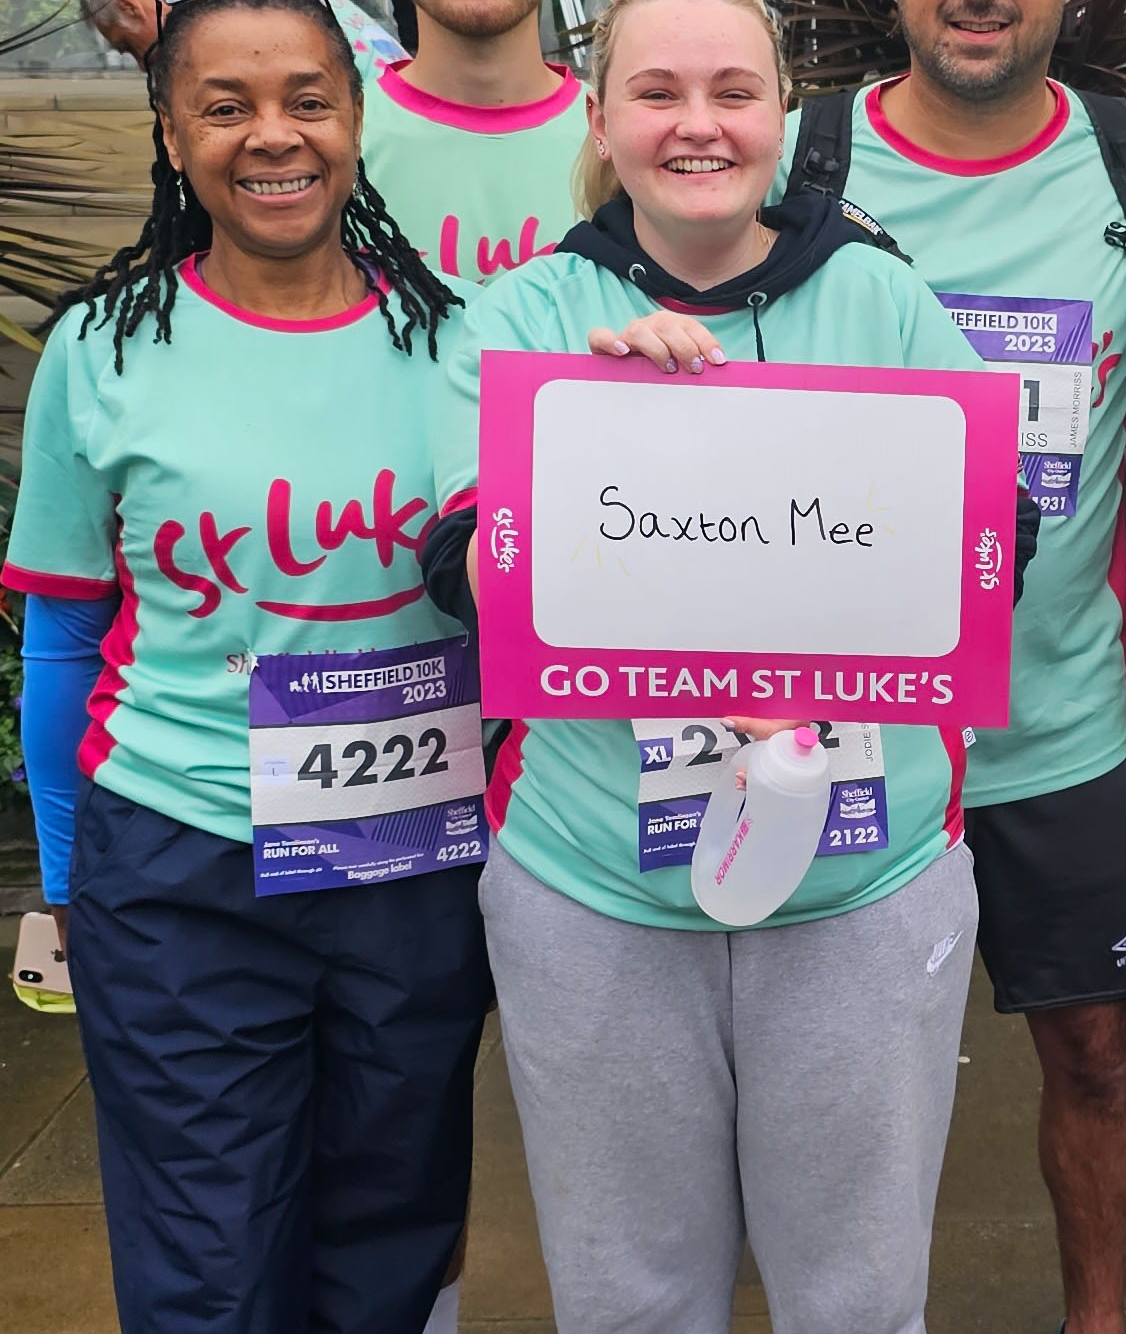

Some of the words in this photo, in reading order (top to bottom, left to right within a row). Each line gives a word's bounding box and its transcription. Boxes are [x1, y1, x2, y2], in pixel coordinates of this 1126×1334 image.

[951, 310, 1019, 330] EFFIELD
[1022, 315, 1055, 331] 10K
[1004, 334, 1056, 353] 2023
[1071, 371, 1082, 416] MORRISS
[1069, 416, 1079, 447] JAMES
[266, 468, 440, 577] Luk
[599, 485, 770, 545] Saxton
[790, 497, 874, 547] Mee
[497, 529, 520, 573] Luke's
[974, 527, 997, 570] Luke's
[325, 666, 413, 691] SHEFFIELD
[415, 661, 445, 678] 10K
[540, 664, 610, 697] GO
[618, 666, 739, 698] TEAM
[751, 669, 801, 700] ST
[814, 670, 954, 705] LUKE'S
[402, 680, 447, 705] 2023
[297, 727, 449, 789] 4222
[643, 744, 673, 765] XL
[681, 721, 840, 767] 22
[863, 732, 874, 762] JODIE
[647, 821, 673, 836] RUN
[674, 818, 697, 831] FOR
[829, 825, 880, 847] 2122
[263, 847, 290, 860] RUN
[291, 845, 316, 857] FOR
[318, 843, 340, 855] ALL
[435, 840, 482, 863] 4222
[347, 867, 390, 881] Baggage
[390, 861, 412, 873] label
